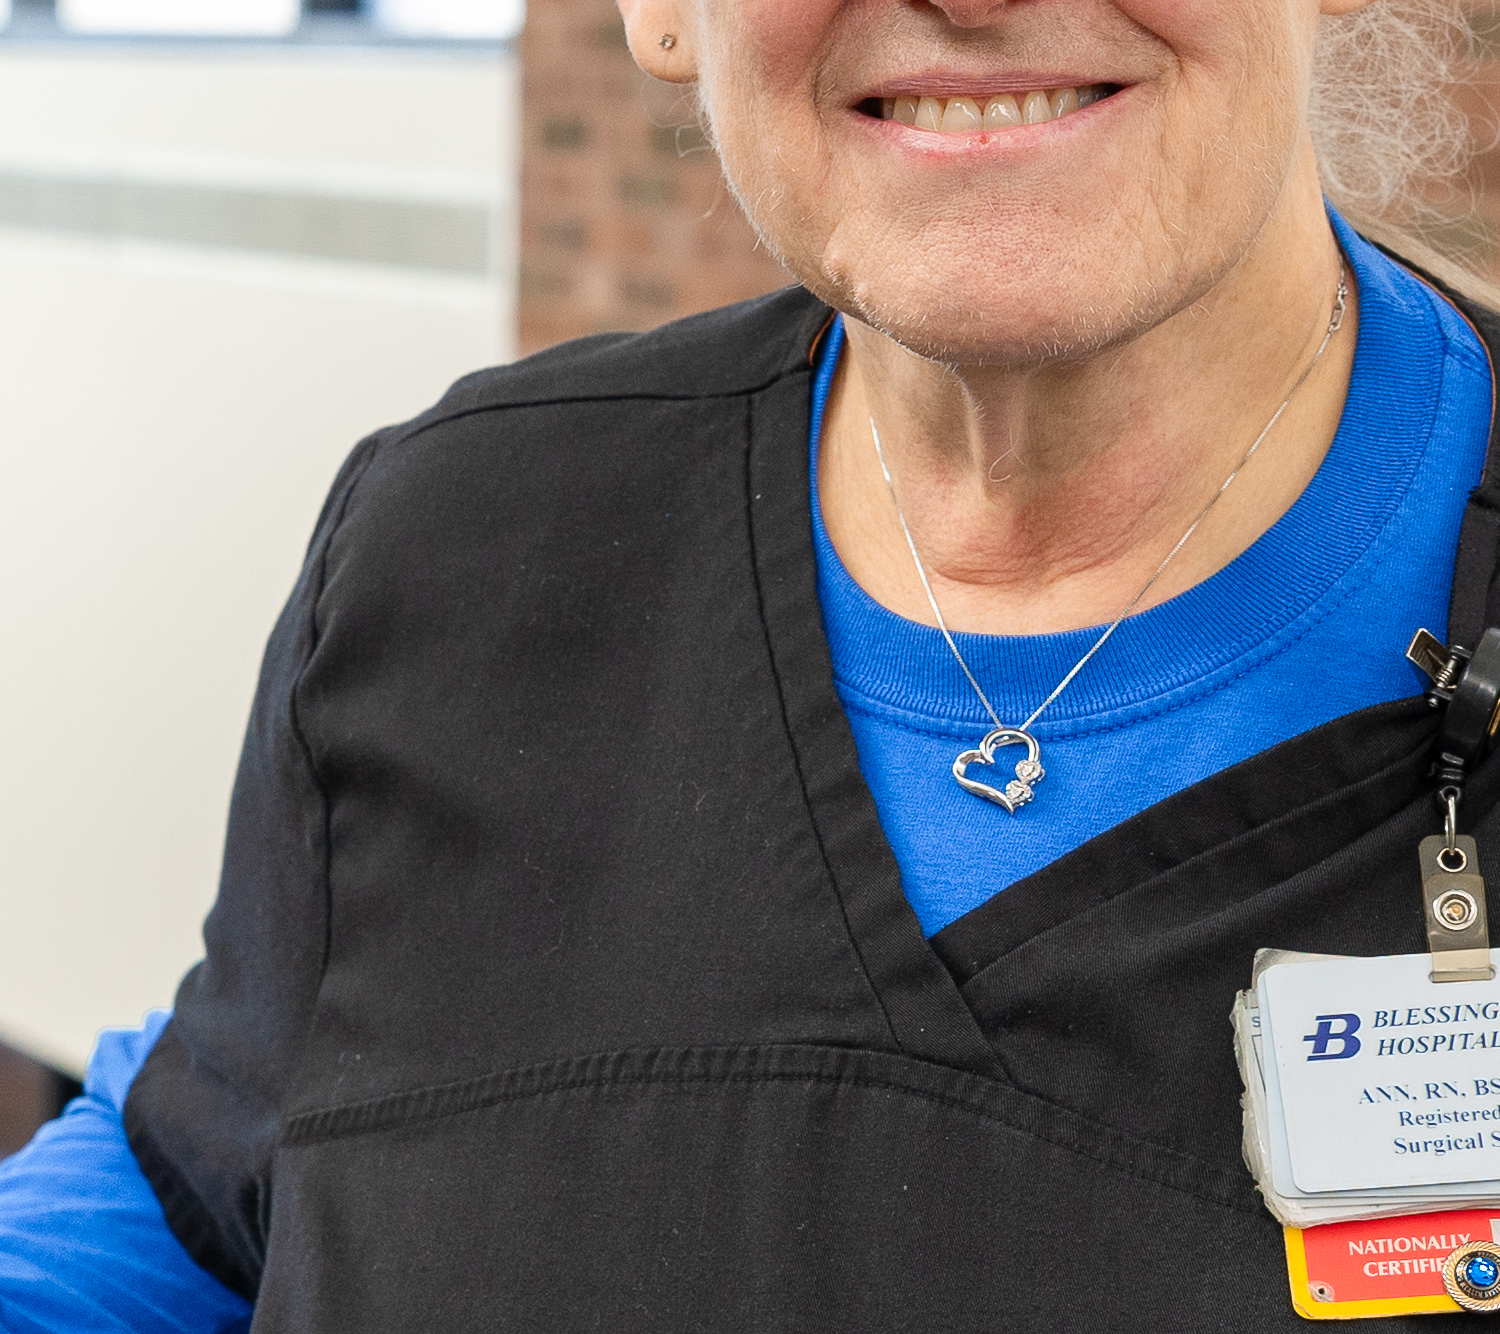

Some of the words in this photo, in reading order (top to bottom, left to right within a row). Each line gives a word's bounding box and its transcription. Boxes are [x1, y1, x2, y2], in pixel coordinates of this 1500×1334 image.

[1372, 1002, 1499, 1028] BLESSING
[1358, 1085, 1418, 1104] ANN,
[1424, 1080, 1467, 1099] RN,
[1394, 1132, 1484, 1156] Surgical
[1349, 1233, 1471, 1255] NATIONALLY
